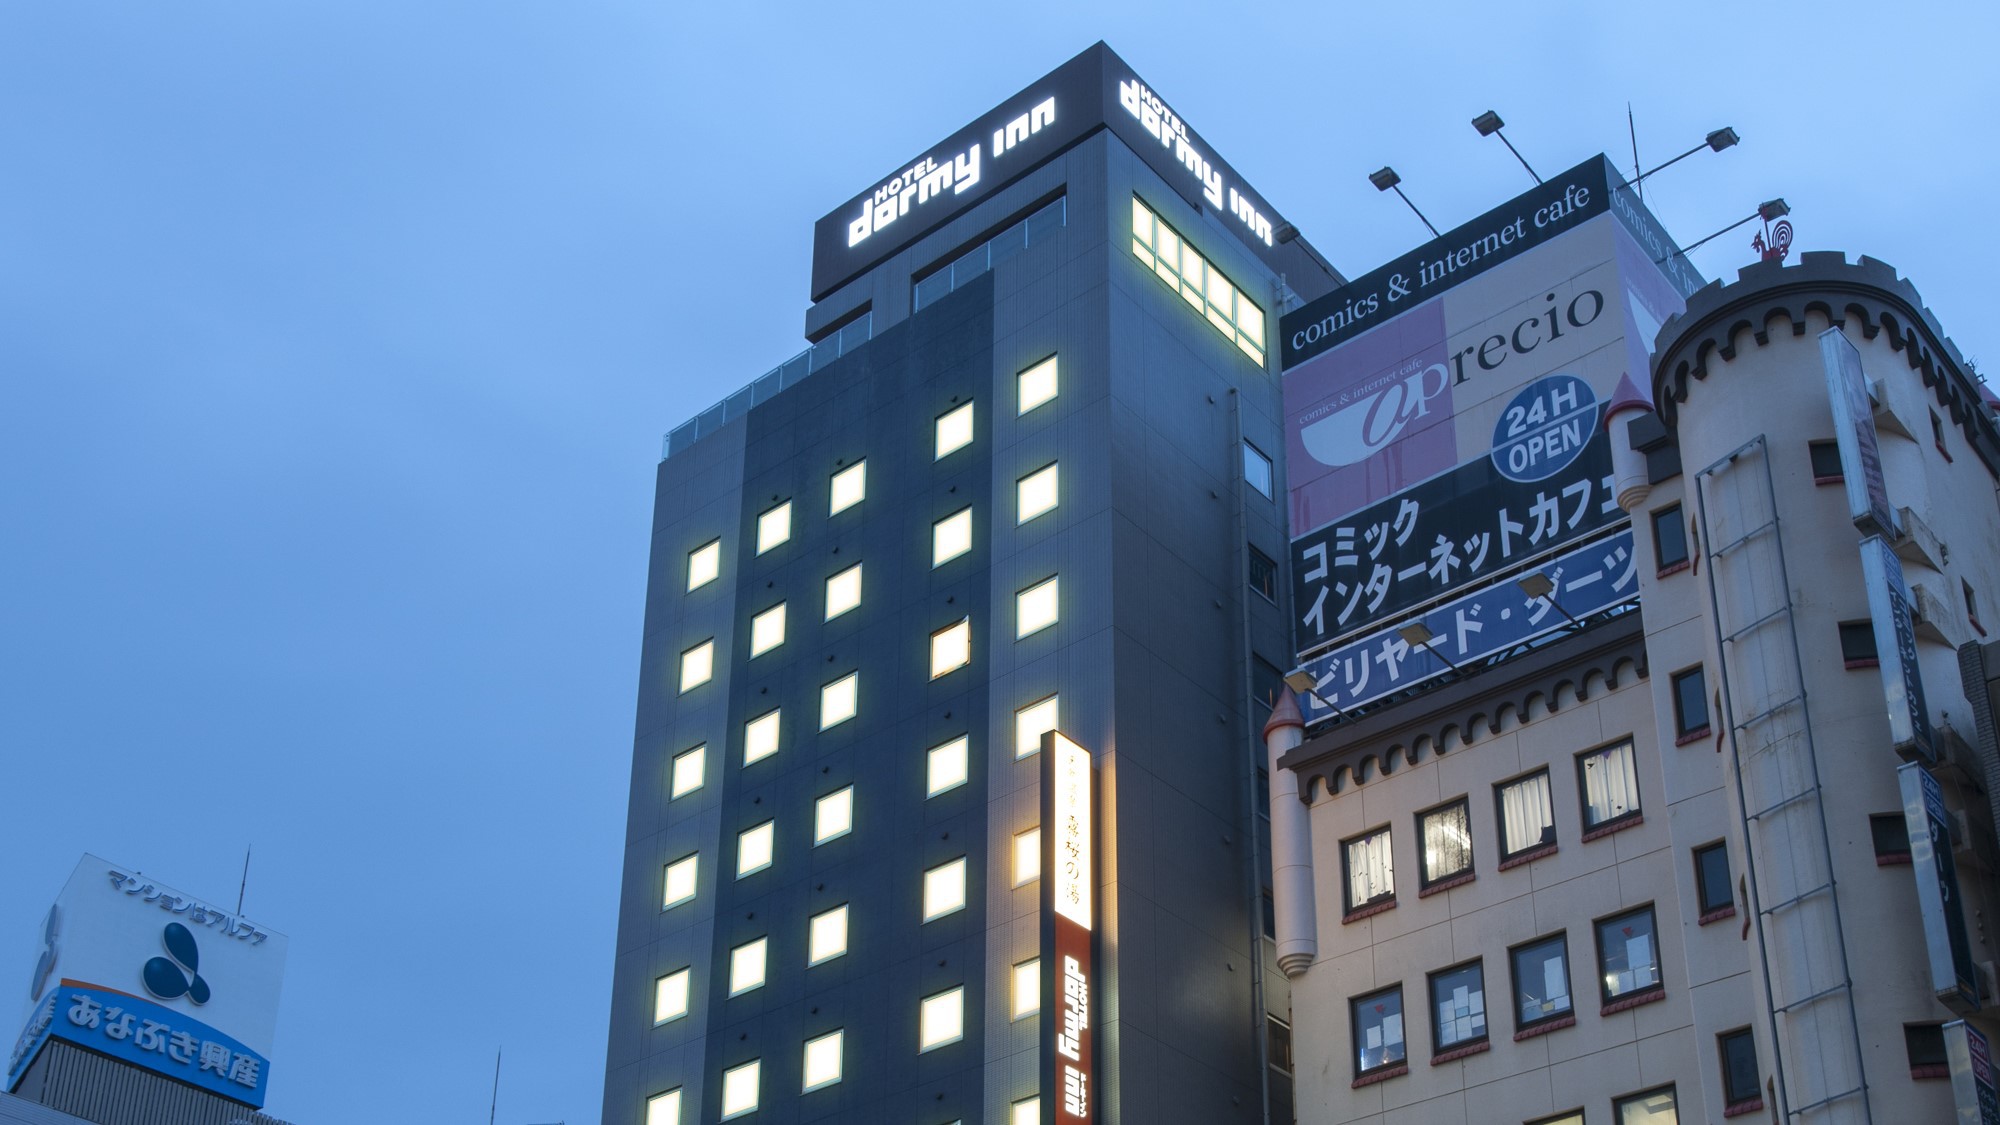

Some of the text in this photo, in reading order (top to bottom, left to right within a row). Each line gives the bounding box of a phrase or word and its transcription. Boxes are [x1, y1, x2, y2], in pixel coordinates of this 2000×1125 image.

[1119, 79, 1224, 211] dormy
[1140, 84, 1190, 143] HOTEL
[848, 143, 981, 248] dormy
[874, 156, 938, 204] HOTEL
[1612, 187, 1663, 259] comics
[1291, 183, 1591, 352] comics & internet cafe
[1299, 358, 1423, 425] comics & internet cafe
[1505, 379, 1579, 438] 24H
[1507, 417, 1582, 474] OPEN
[1302, 498, 1420, 584] コミック
[107, 869, 269, 946] マンションはアルファ
[67, 993, 261, 1088] あなぶき興産
[1058, 954, 1086, 1062] dormy
